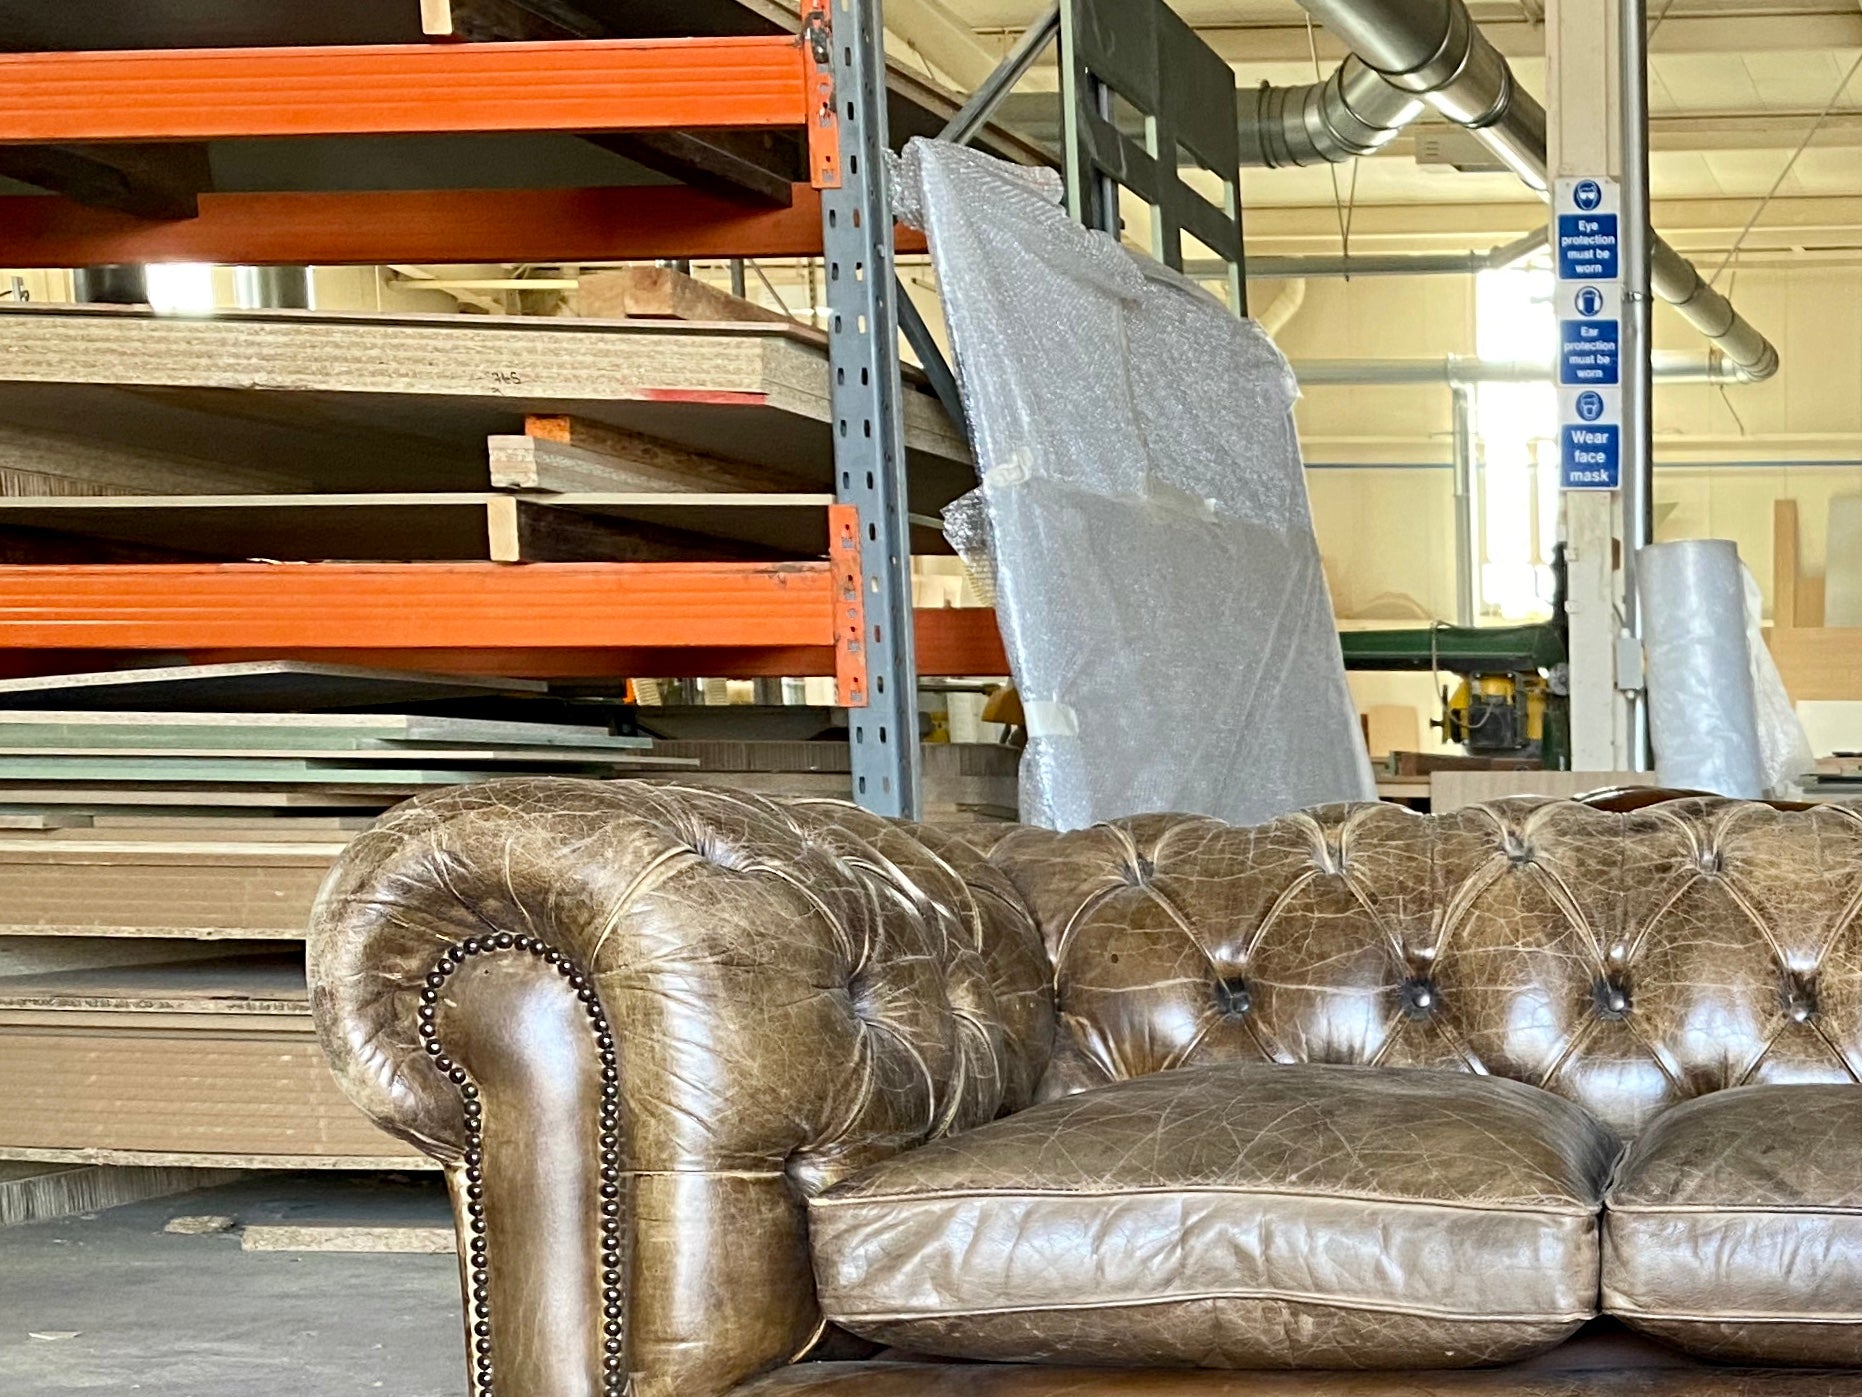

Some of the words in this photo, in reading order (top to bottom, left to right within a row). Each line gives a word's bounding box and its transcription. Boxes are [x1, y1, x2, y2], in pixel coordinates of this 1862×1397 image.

[1578, 220, 1599, 233] Eye
[1561, 234, 1616, 247] protection
[1567, 249, 1594, 259] must
[1596, 248, 1610, 259] be
[1575, 264, 1603, 273] worn
[1580, 326, 1599, 337] Ear
[1564, 340, 1616, 353] protection
[1569, 354, 1595, 364] must
[1596, 354, 1610, 364] be
[1576, 369, 1604, 378] worn
[1570, 430, 1609, 444] Wear
[1574, 450, 1606, 463] face
[1570, 469, 1610, 482] mask
